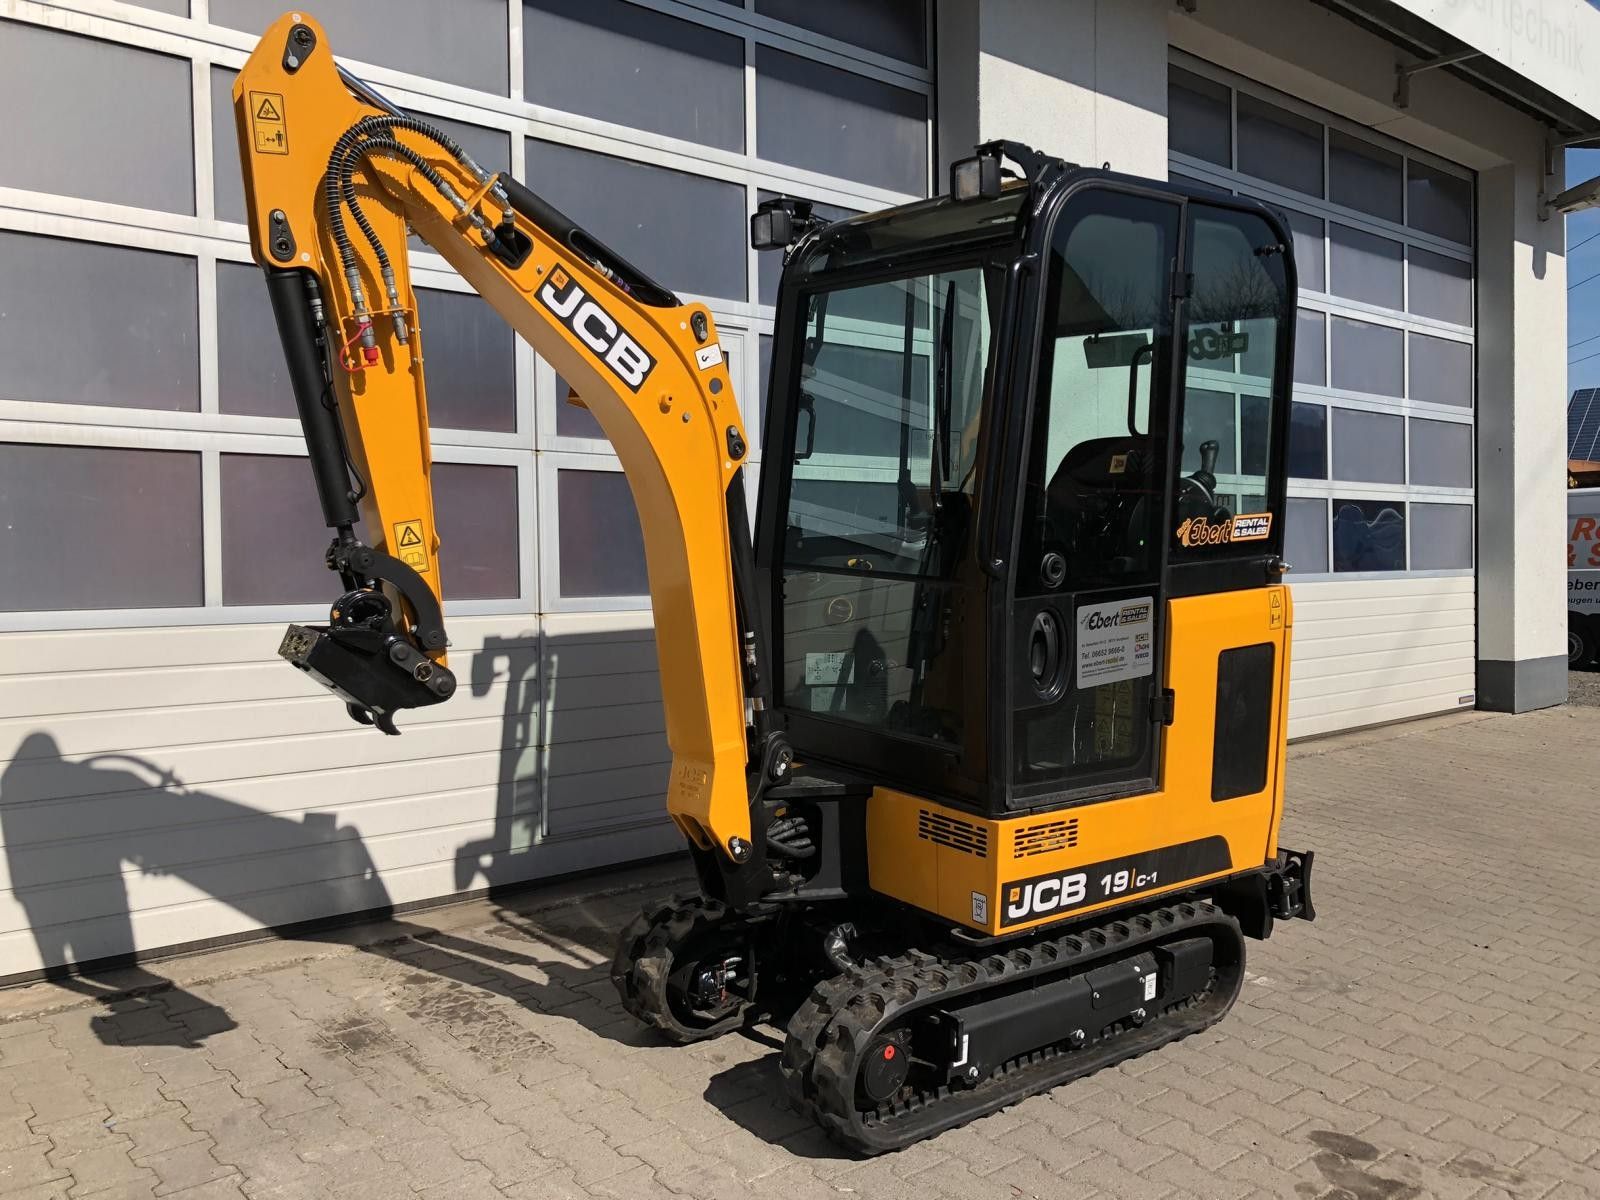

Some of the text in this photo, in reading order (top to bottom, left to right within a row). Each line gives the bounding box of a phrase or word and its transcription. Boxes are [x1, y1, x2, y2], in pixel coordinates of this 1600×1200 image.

[541, 283, 650, 386] JCB
[1188, 517, 1232, 546] Ebert
[1235, 518, 1268, 527] RENTAL
[1241, 527, 1266, 536] SALES
[1571, 516, 1600, 541] R
[1567, 597, 1593, 605] ugen
[1088, 611, 1120, 630] Ebert
[1122, 607, 1148, 617] RENTAL
[1008, 873, 1087, 918] JCB
[1101, 870, 1129, 896] 19
